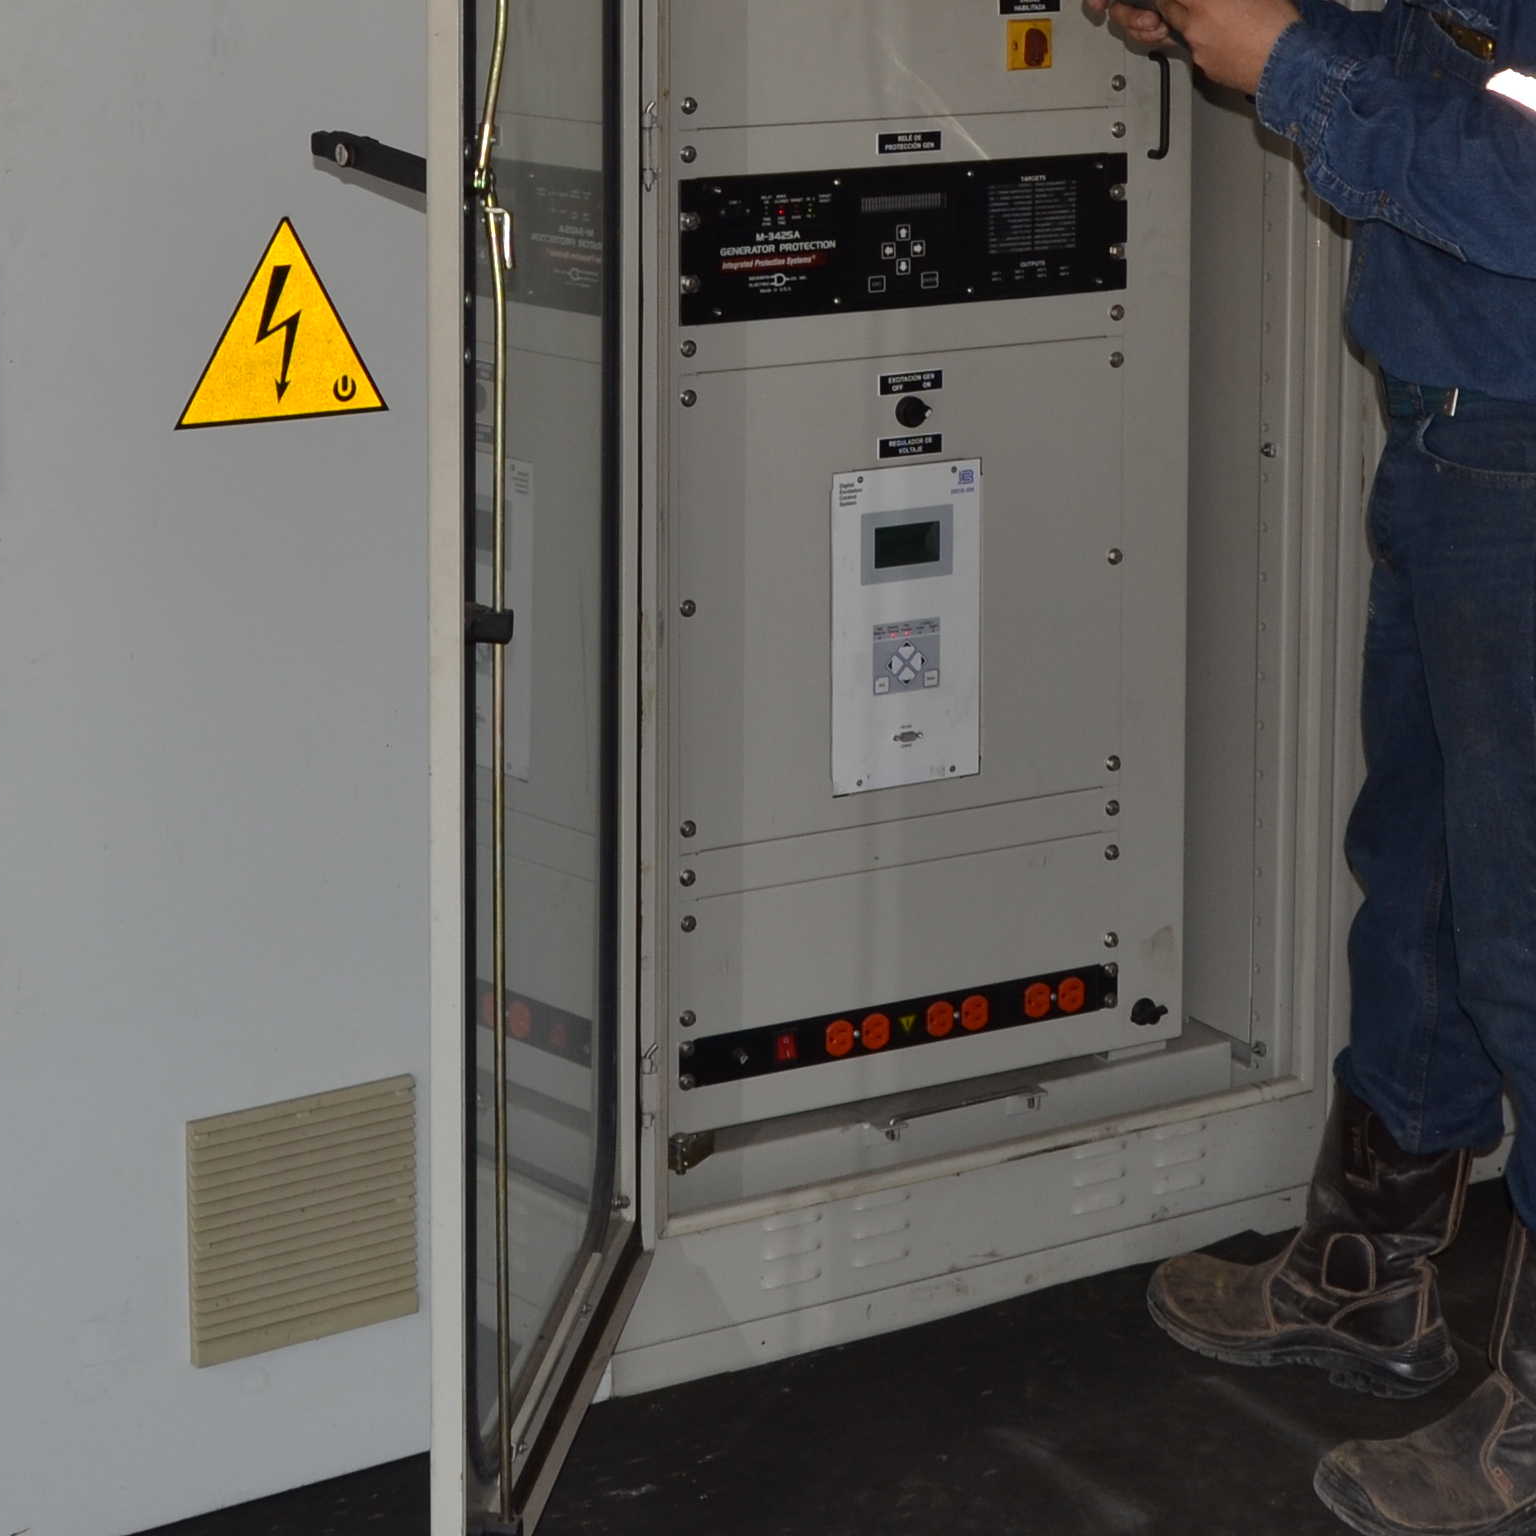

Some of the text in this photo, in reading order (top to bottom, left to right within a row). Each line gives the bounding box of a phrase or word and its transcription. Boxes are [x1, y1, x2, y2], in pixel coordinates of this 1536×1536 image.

[897, 134, 922, 142] RELÉ DE
[1020, 174, 1047, 182] TARGETS
[755, 230, 801, 242] M-3425A
[720, 239, 836, 257] GENERATOR PROTECTION
[721, 259, 754, 270] Integrated
[754, 257, 786, 267] Protection
[1020, 260, 1046, 268] OUTPUTS
[922, 373, 935, 381] GEN
[891, 384, 904, 392] OFF
[888, 436, 933, 447] REGULADOR DE
[898, 445, 923, 454] VOLTAJE
[839, 482, 855, 490] Digital
[839, 500, 857, 508] System
